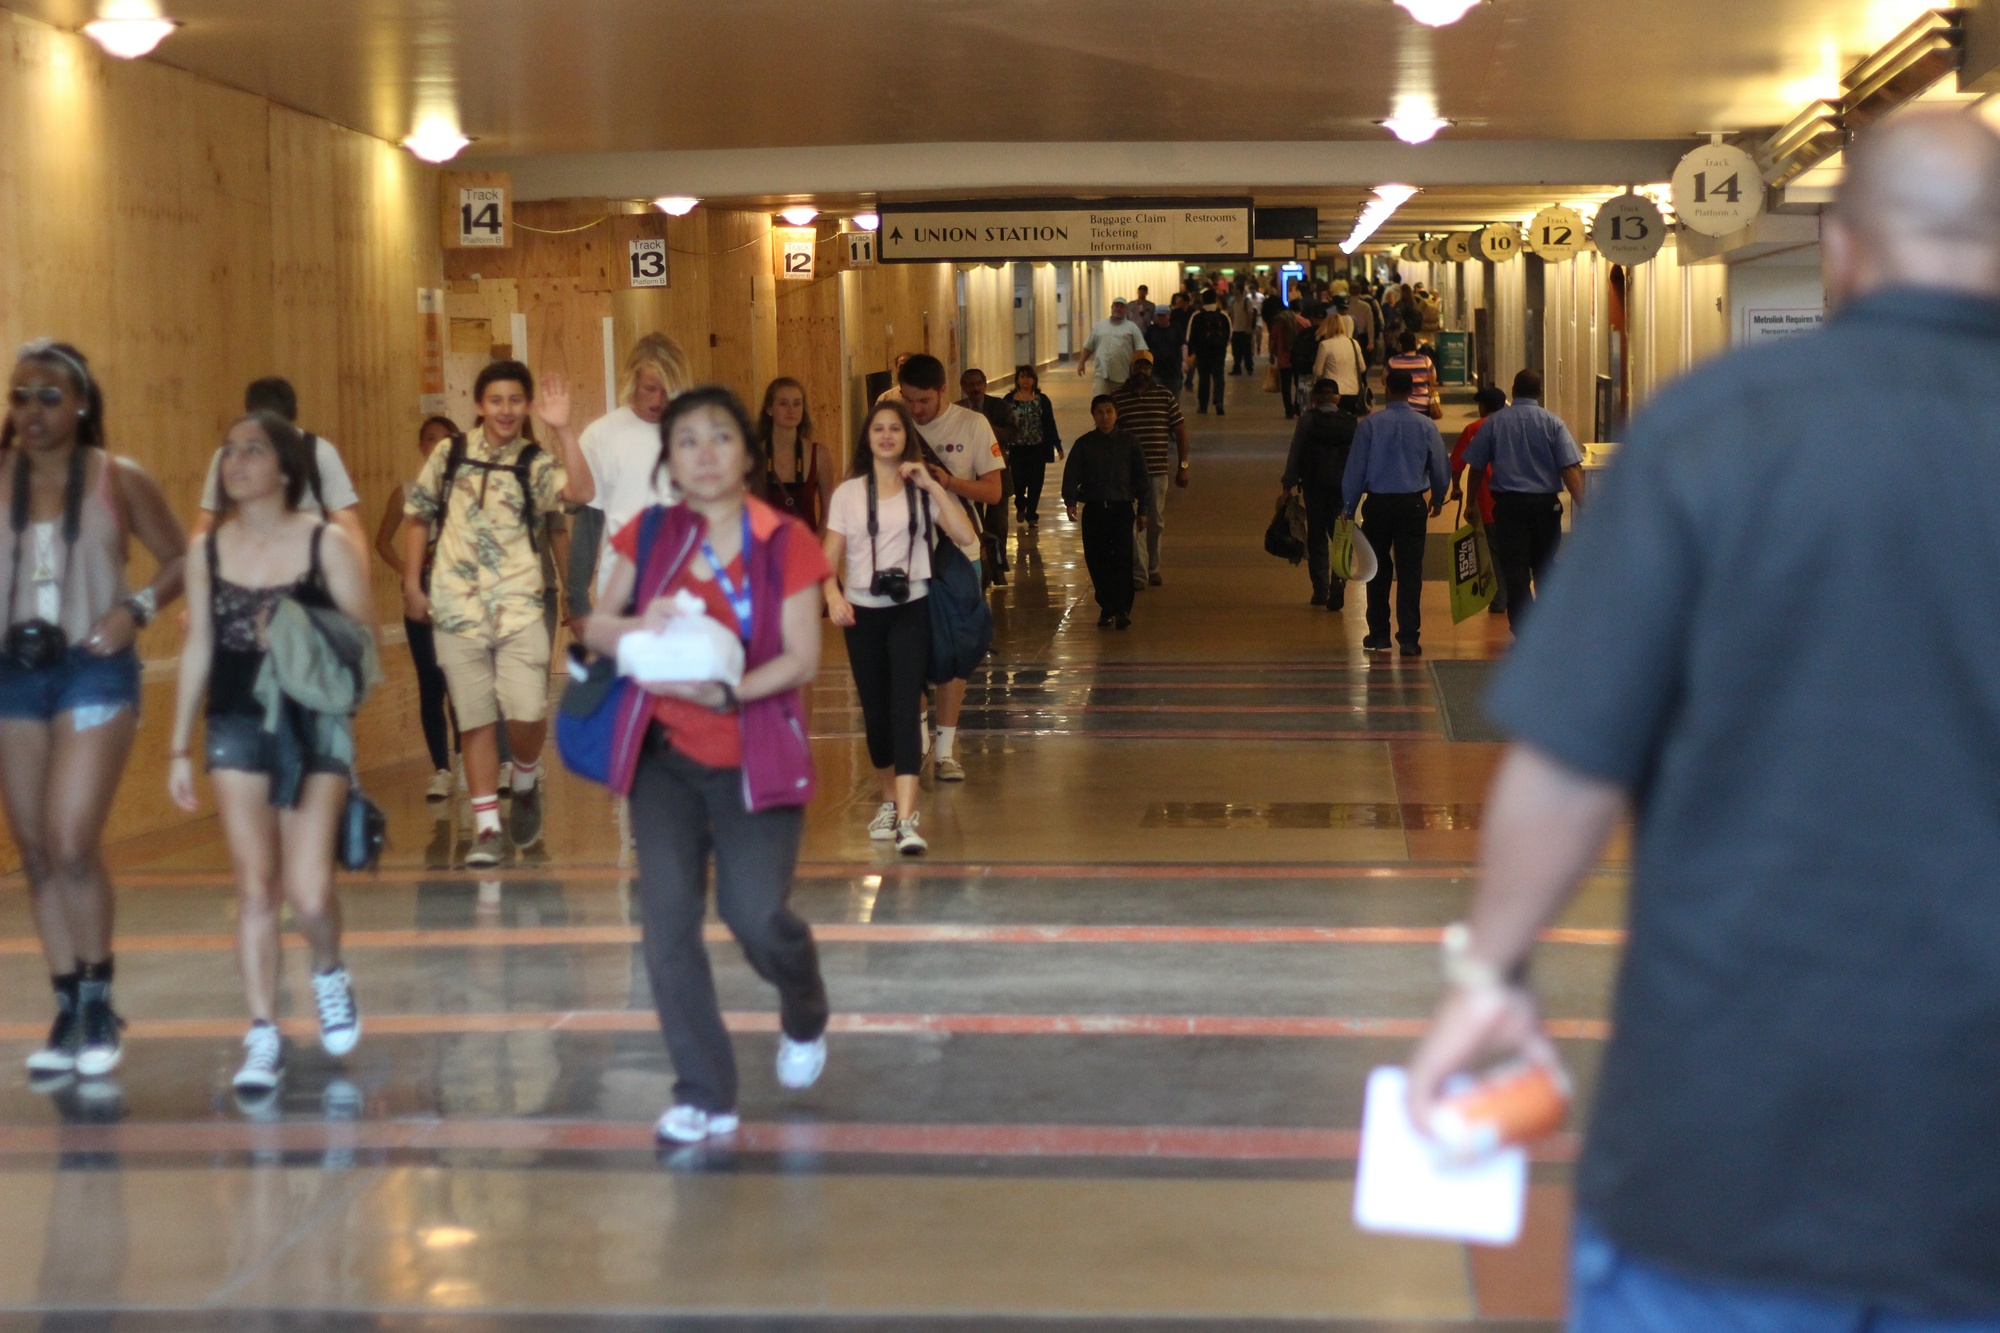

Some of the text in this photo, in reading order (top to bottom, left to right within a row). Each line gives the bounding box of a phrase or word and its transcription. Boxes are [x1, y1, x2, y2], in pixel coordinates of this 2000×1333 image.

[1705, 158, 1730, 167] Track
[1693, 171, 1743, 203] 14
[464, 188, 499, 200] Track
[1619, 204, 1640, 212] Track
[1694, 208, 1739, 217] Platform A
[461, 203, 502, 235] 14
[1090, 213, 1167, 226] Baggage Claim
[1185, 213, 1237, 223] Restrooms
[1546, 216, 1569, 224] Track
[1090, 228, 1139, 239] Ticketing
[1610, 215, 1649, 241] 13
[462, 235, 502, 244] Platform B
[914, 226, 1068, 243] UNION STATION
[1542, 226, 1572, 246] 12
[632, 239, 662, 250] Track
[787, 242, 809, 251] Track
[1090, 242, 1152, 251] Information
[1457, 242, 1467, 254] 8
[1490, 236, 1511, 251] 10
[850, 241, 871, 261] 11
[630, 251, 665, 278] 13
[784, 252, 812, 273] 12
[632, 277, 665, 286] Platform B
[1753, 315, 1784, 324] Metrolink
[1785, 315, 1814, 325] Requires
[1458, 540, 1470, 581] 15%
